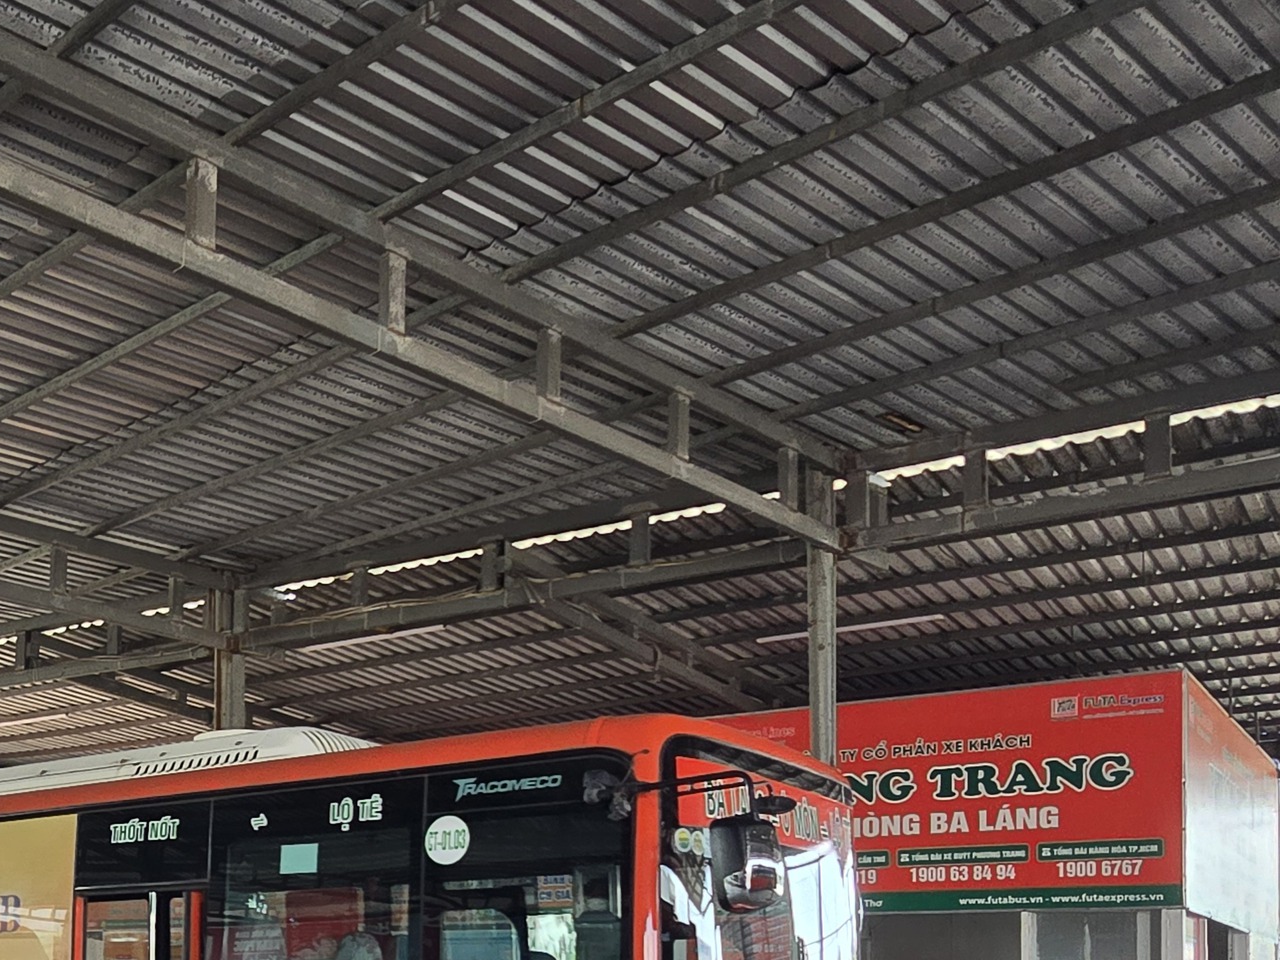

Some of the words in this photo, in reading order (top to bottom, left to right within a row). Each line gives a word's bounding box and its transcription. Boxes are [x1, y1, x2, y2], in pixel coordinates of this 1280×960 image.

[1083, 695, 1117, 709] FUTA
[1119, 694, 1164, 706] Express
[840, 749, 858, 763] TY
[862, 740, 888, 760] CỔ
[892, 738, 937, 759] PHẦN
[942, 740, 964, 754] XE
[968, 733, 1032, 750] KHÁCH
[452, 775, 562, 802] TRACOMECO
[926, 752, 1134, 802] TRANG
[330, 797, 354, 831] LỘ
[854, 811, 920, 838] ÒNG
[930, 811, 969, 834] BA
[978, 804, 1059, 831] LÁNG
[110, 818, 147, 843] THỐT
[148, 815, 179, 840] NỐT
[909, 867, 946, 883] 1900
[950, 866, 969, 882] 63
[973, 865, 992, 881] 84
[996, 864, 1016, 880] 94
[1055, 860, 1097, 878] 1900
[1101, 859, 1143, 877] 6767
[864, 898, 883, 907] Thơ
[959, 895, 1043, 905] www.futabus.vn
[1051, 892, 1164, 904] www.futaexpress.vn
